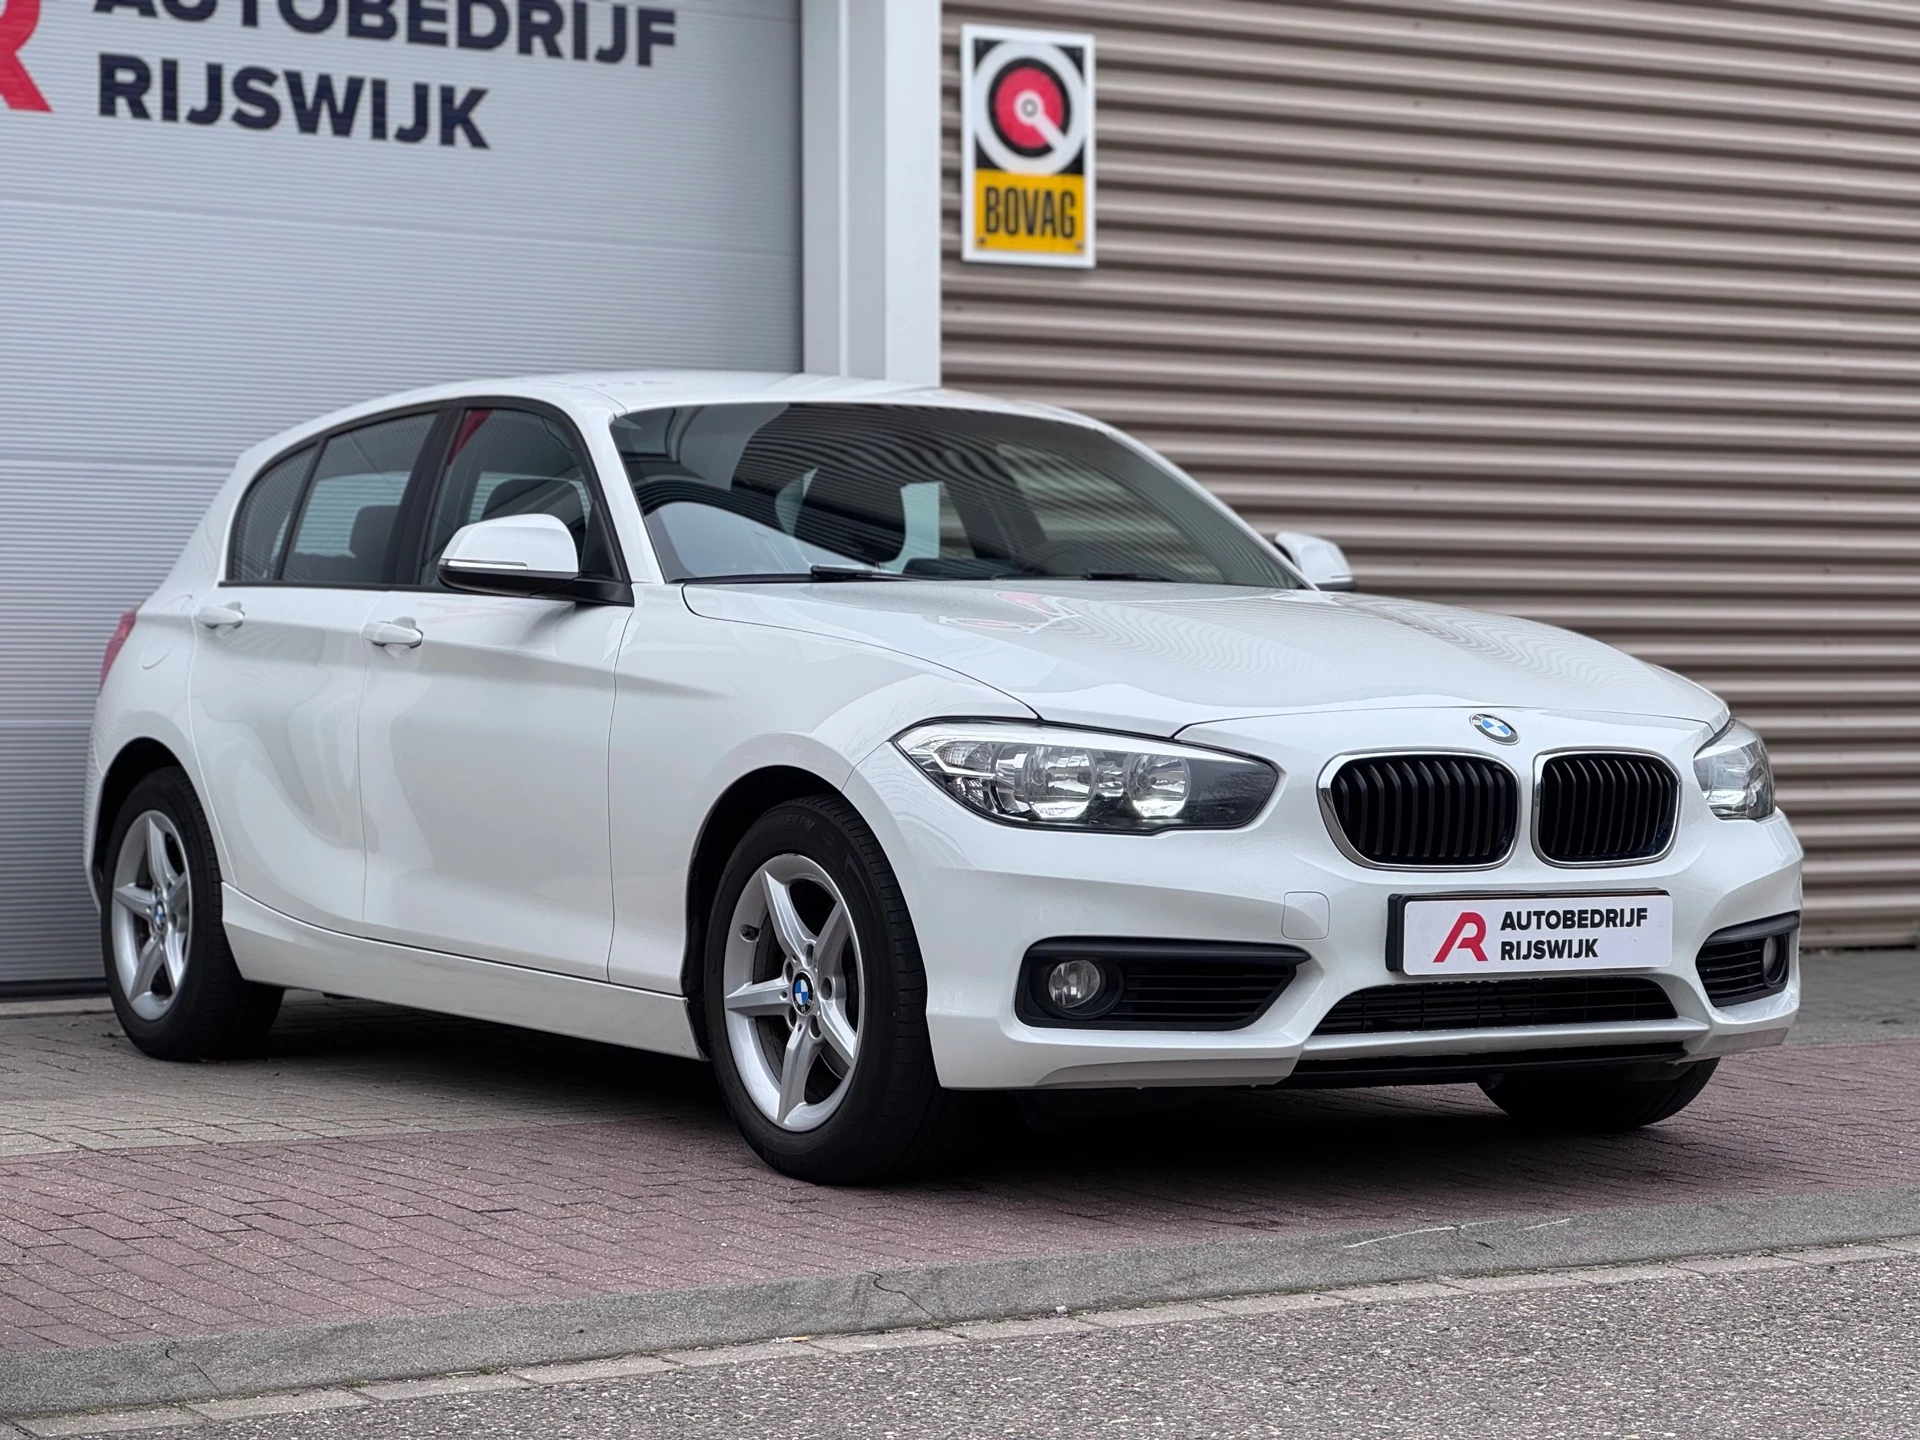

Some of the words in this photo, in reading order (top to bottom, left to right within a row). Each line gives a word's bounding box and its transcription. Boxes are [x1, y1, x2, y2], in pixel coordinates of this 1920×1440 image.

[98, 52, 491, 150] RIJSWIJK
[984, 185, 1076, 239] BOVAG
[1500, 907, 1648, 931] AUTOBEDRIJF
[1500, 938, 1599, 961] RIJSWIJK
